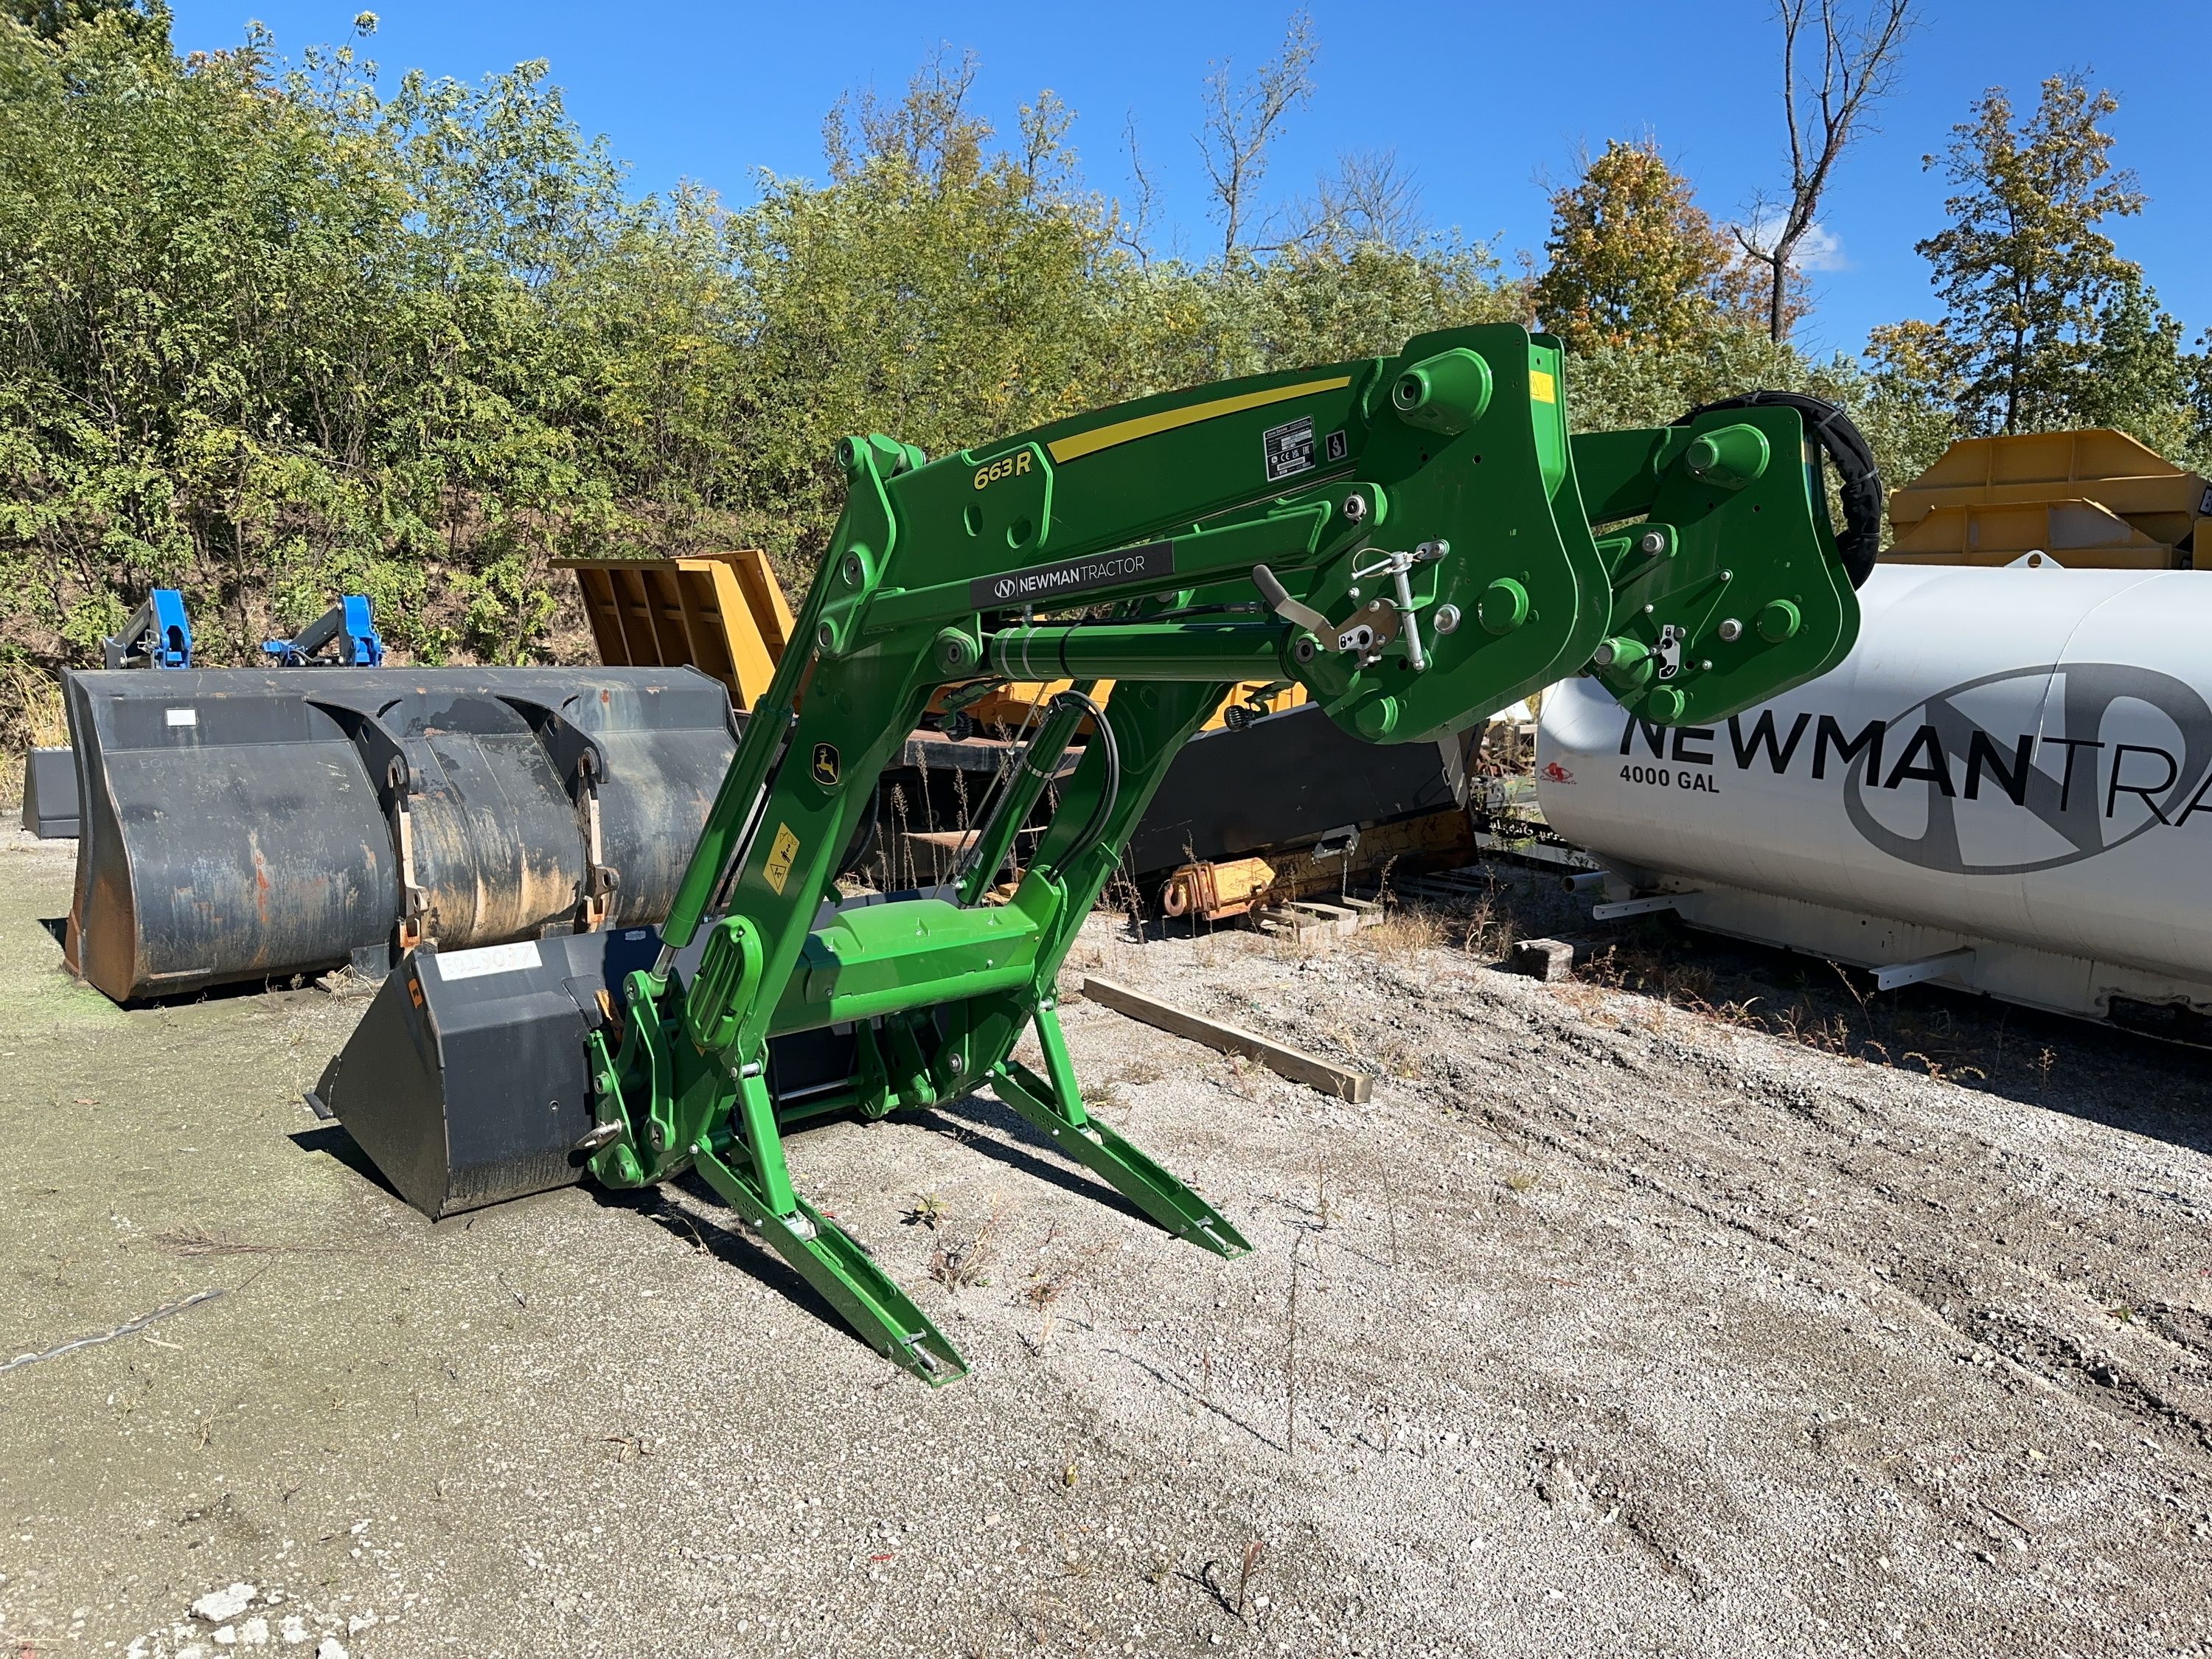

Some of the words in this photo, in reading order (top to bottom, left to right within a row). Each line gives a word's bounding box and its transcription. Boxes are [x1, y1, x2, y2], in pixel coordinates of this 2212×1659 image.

[1019, 555, 1145, 593] NEWMANTRACTOR
[1620, 765, 1670, 787] 4000
[1677, 771, 1720, 794] GAL
